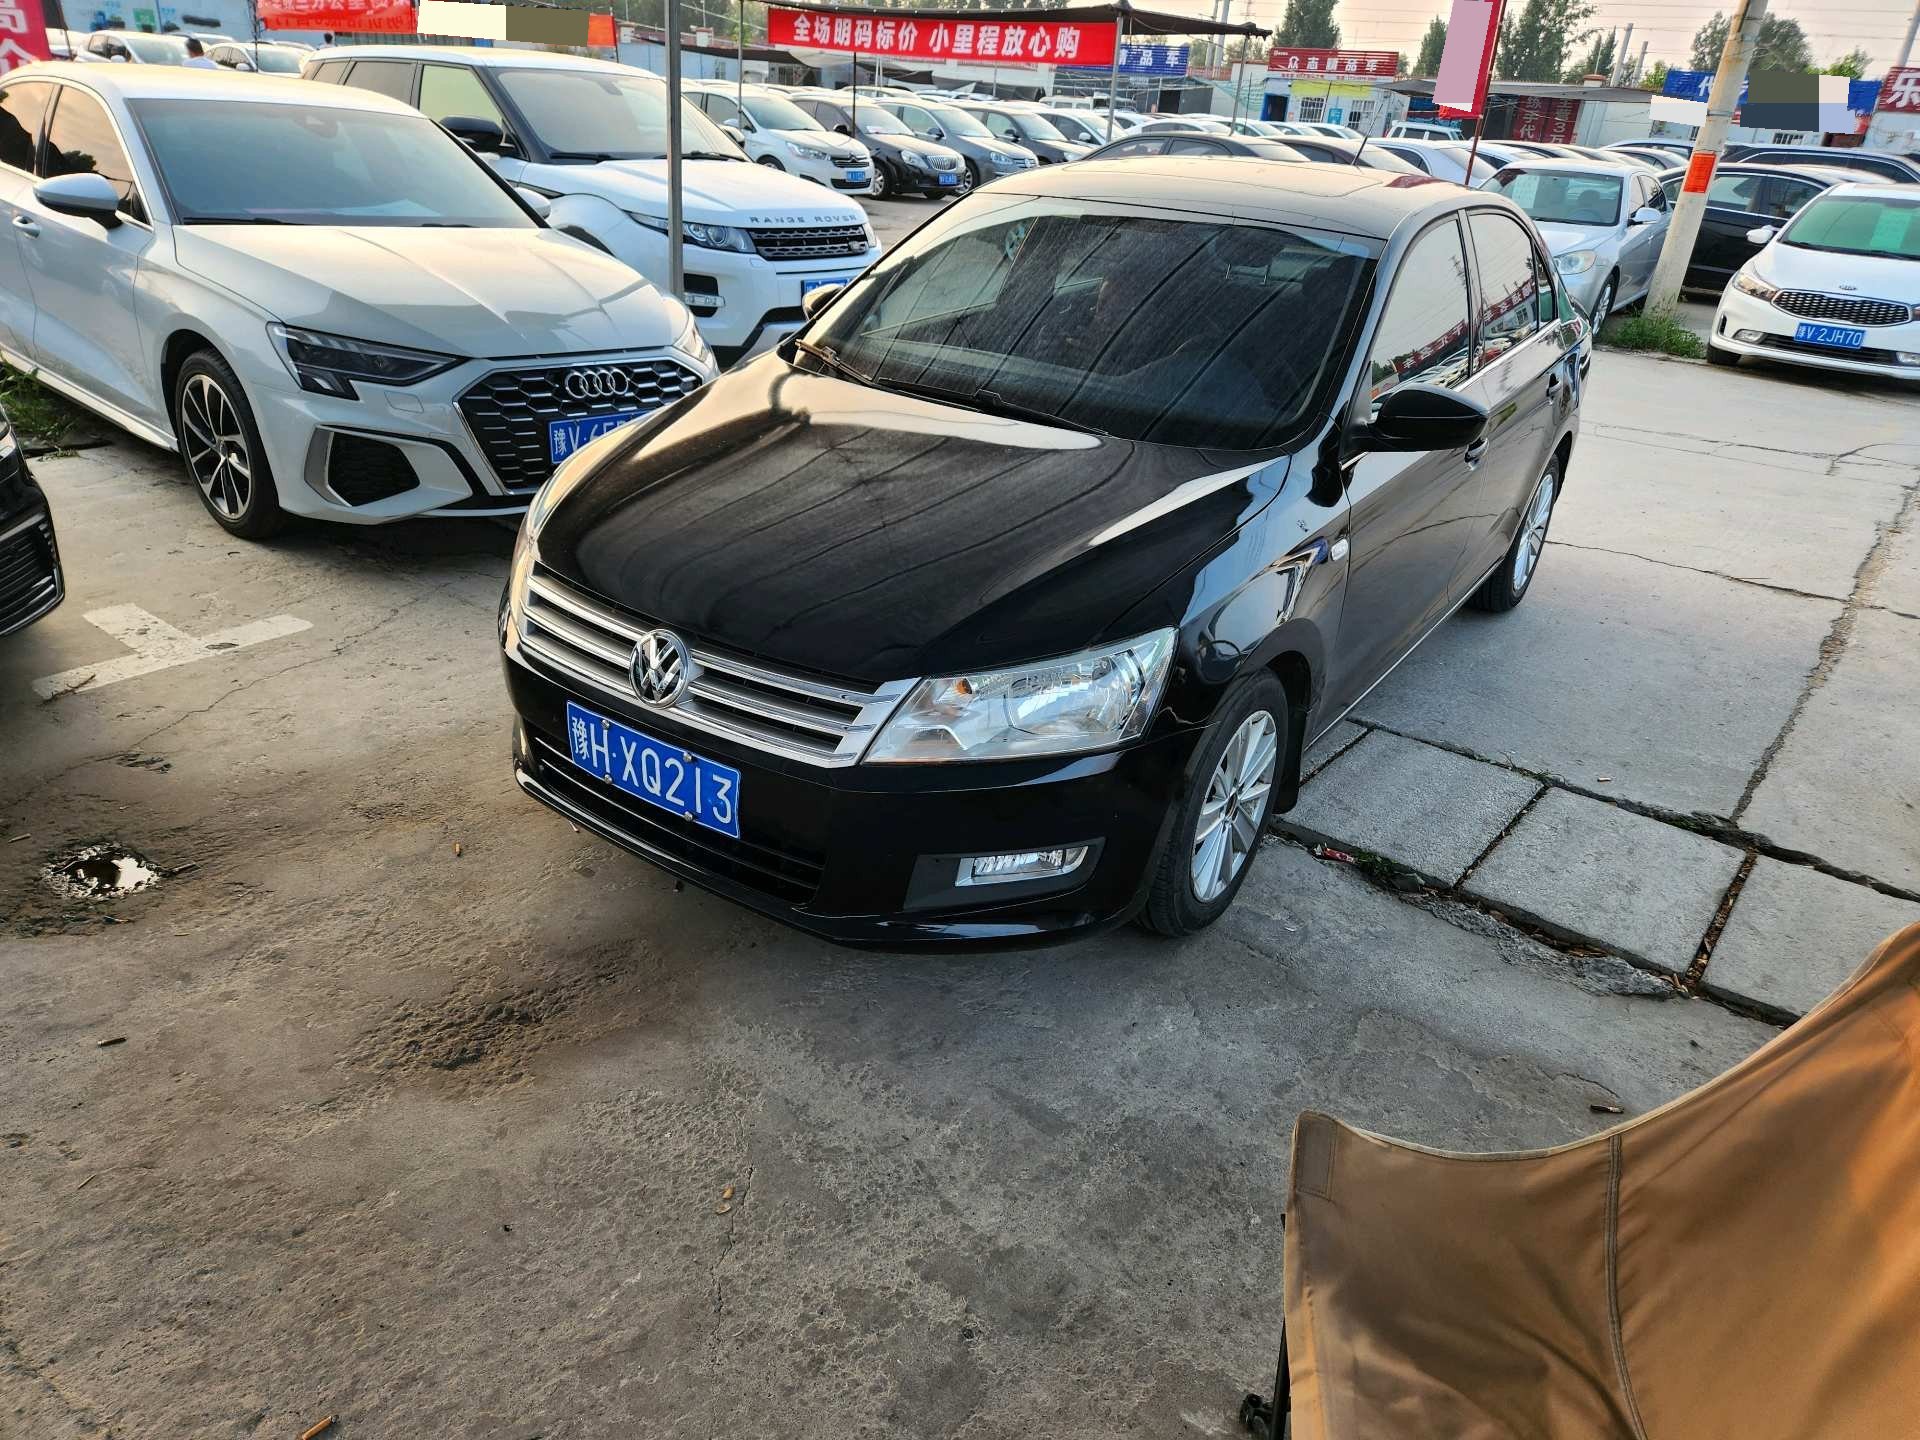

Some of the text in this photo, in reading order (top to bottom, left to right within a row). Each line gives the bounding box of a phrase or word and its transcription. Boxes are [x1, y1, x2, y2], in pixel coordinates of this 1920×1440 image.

[793, 13, 1080, 59] 全场明码标价 小里程放心购
[572, 716, 732, 824] 豫H·XQ213
